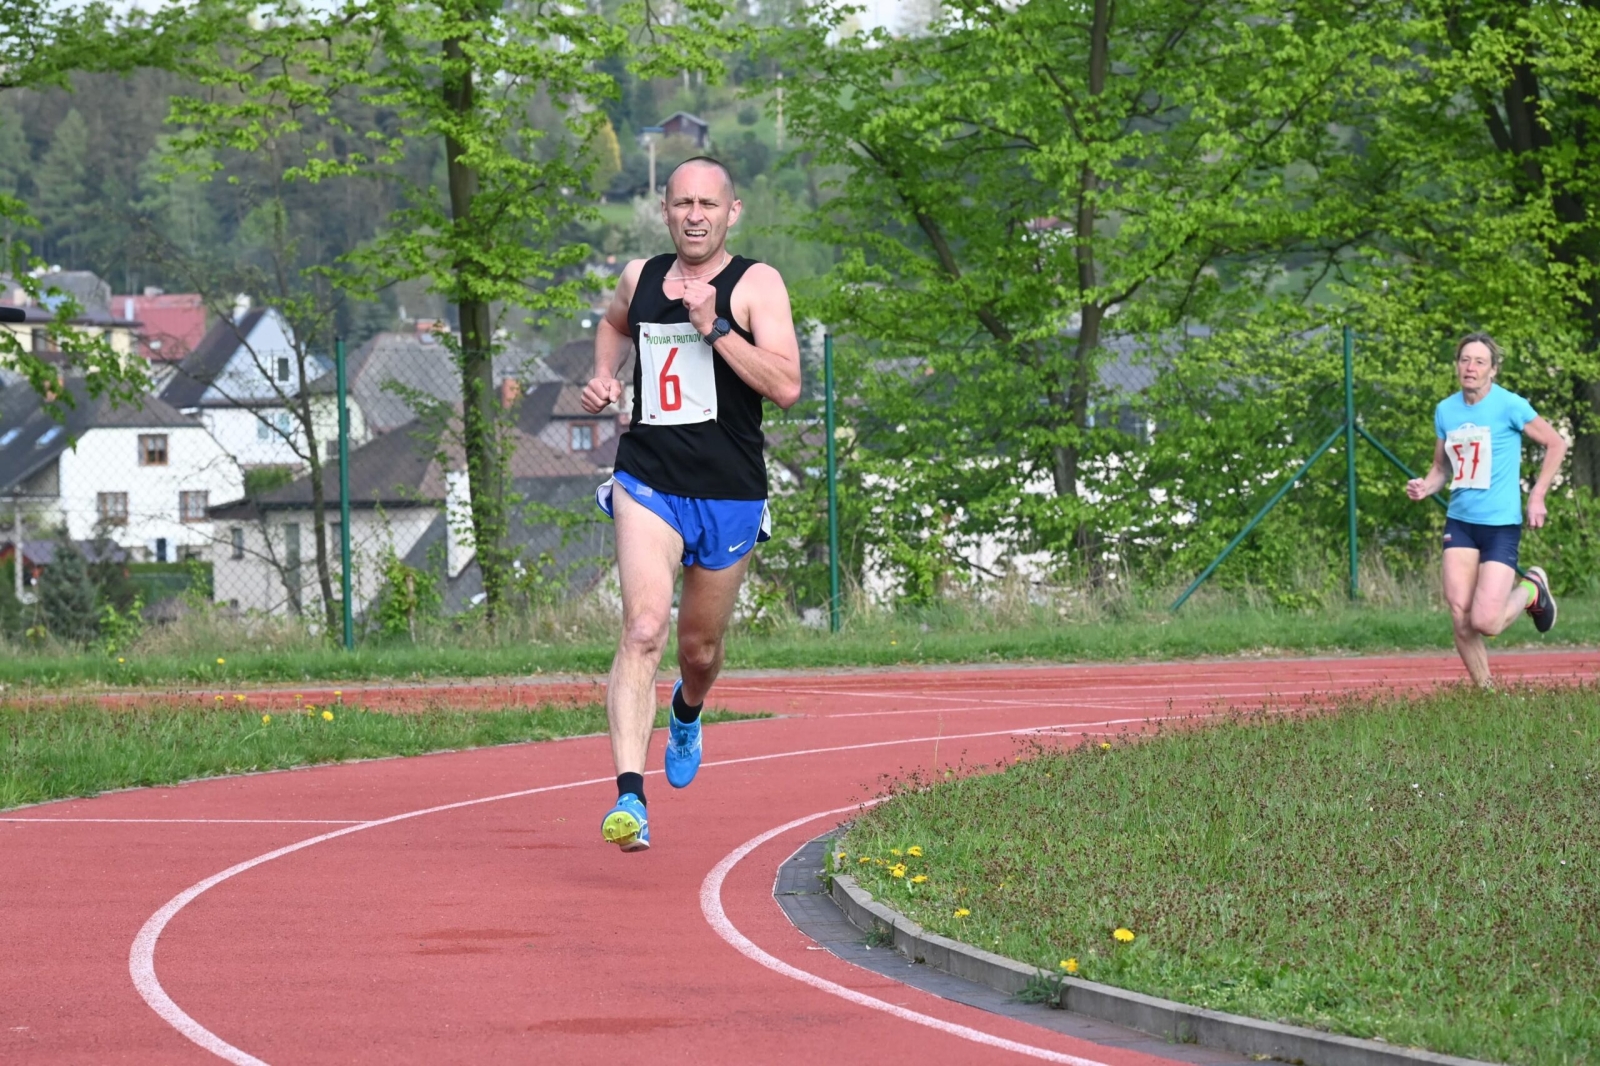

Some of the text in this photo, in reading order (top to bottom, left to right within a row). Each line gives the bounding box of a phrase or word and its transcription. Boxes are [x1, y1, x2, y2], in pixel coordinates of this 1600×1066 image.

[673, 333, 701, 344] TRUTNOV
[659, 347, 682, 411] 6
[1452, 442, 1480, 481] 57
